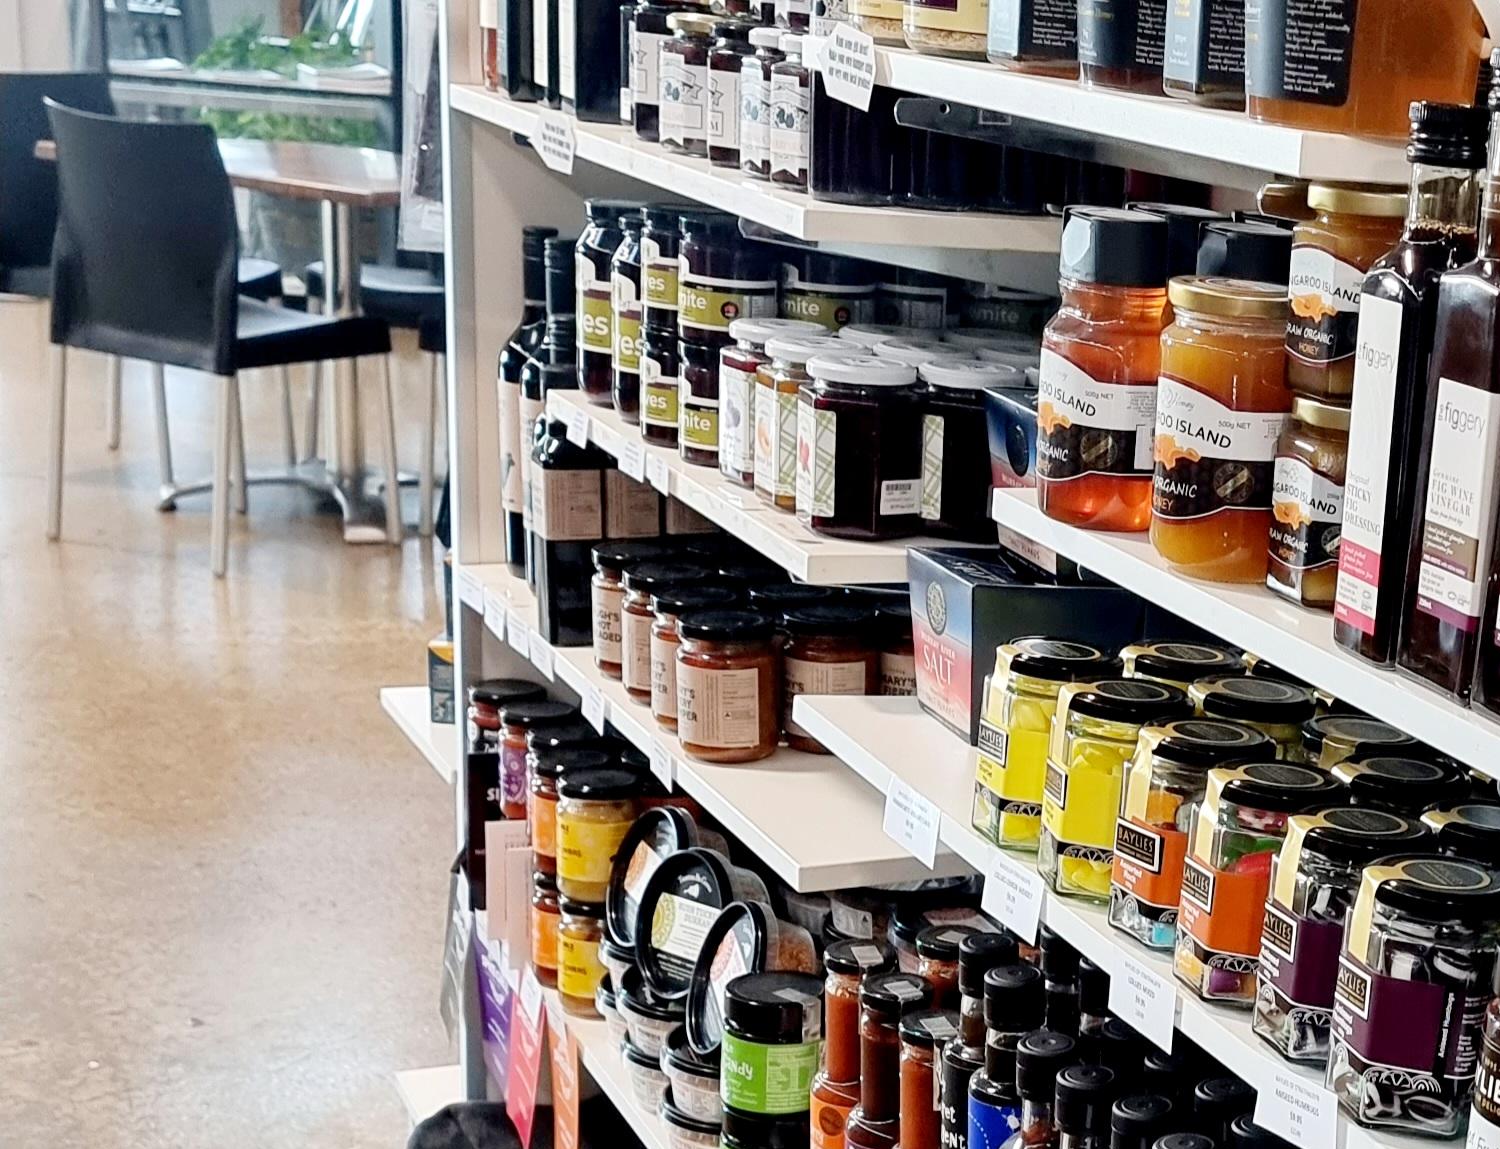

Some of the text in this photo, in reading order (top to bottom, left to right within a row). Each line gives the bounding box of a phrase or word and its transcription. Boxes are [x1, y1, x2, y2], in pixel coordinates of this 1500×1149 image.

[1287, 322, 1334, 346] RAW ORGANIC
[1054, 388, 1096, 418] ISLAND
[1445, 401, 1485, 437] figgery
[1176, 421, 1232, 449] ISLAND
[1155, 477, 1197, 499] ORGANIC
[1346, 483, 1372, 503] STICKY
[1432, 479, 1475, 505] FIG WINE
[1301, 493, 1337, 516] ISLAND
[1430, 492, 1471, 517] VINEGAR
[1344, 511, 1381, 537] DRESSING
[923, 644, 955, 690] SALT
[1116, 824, 1154, 853] BAYLIES
